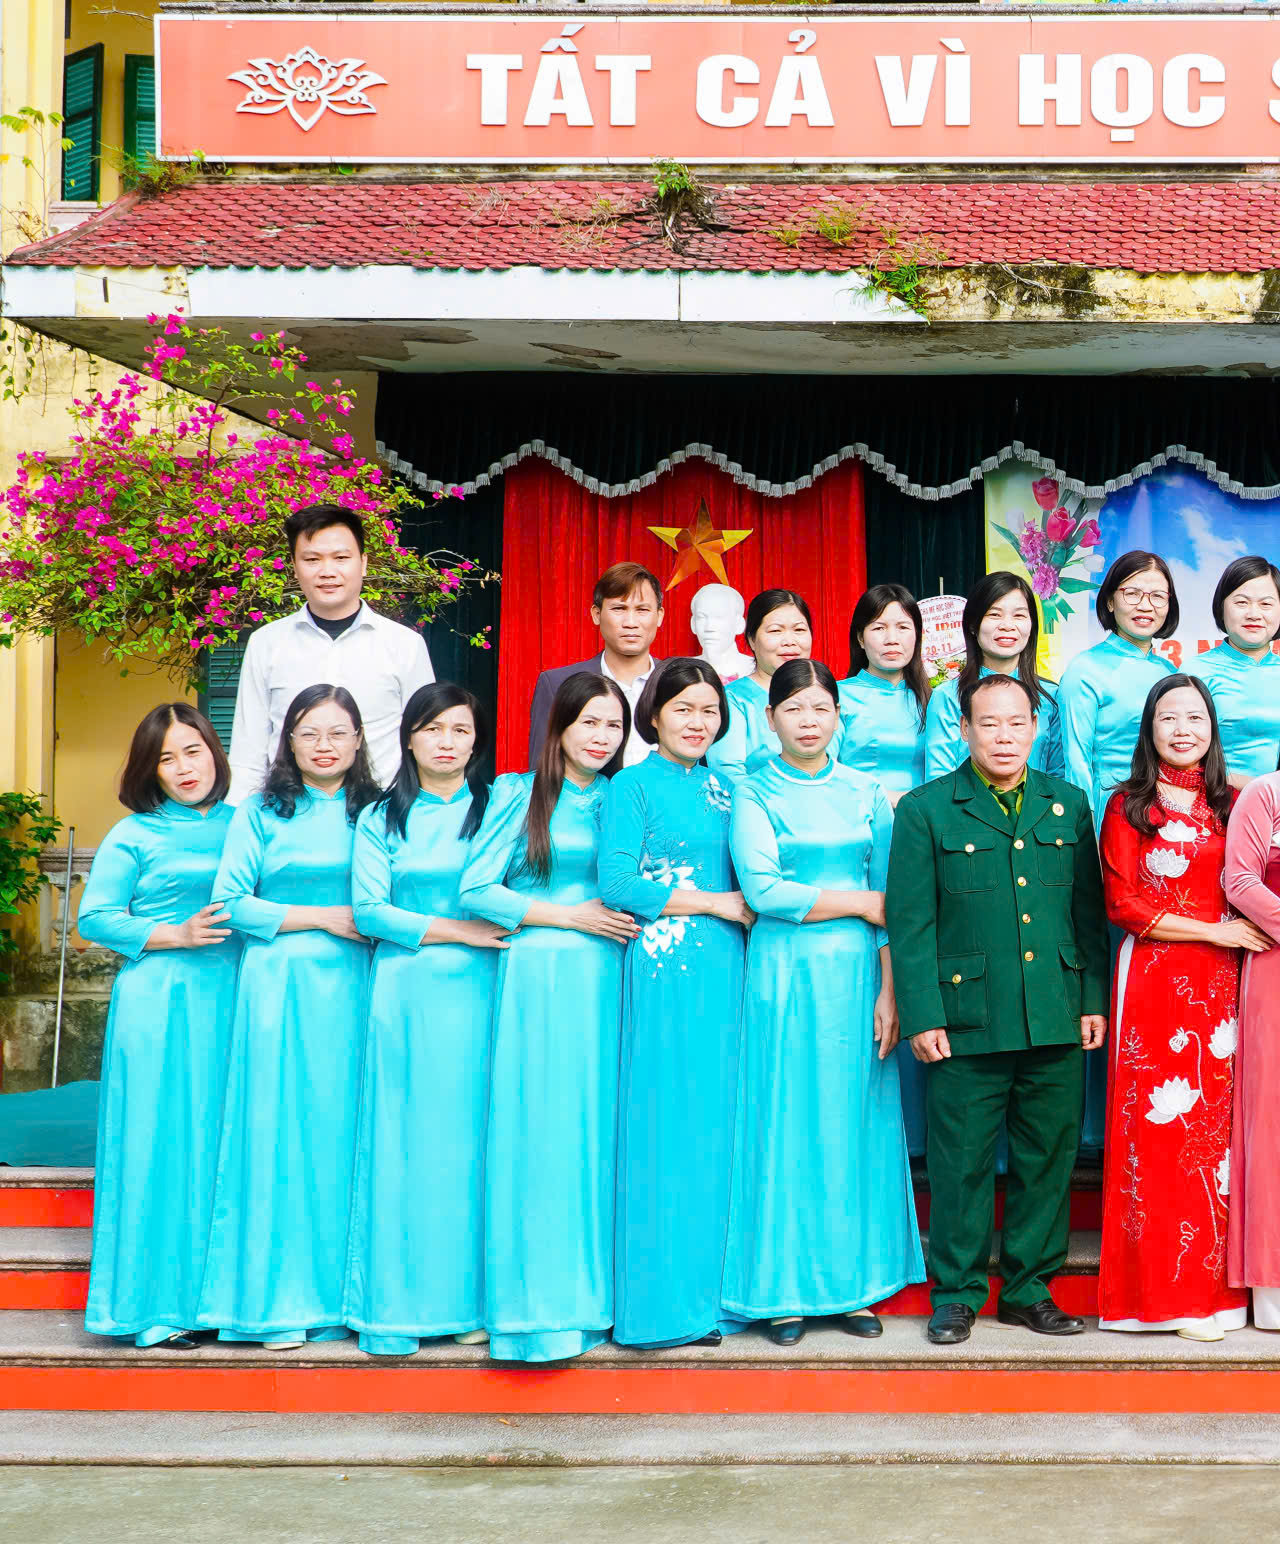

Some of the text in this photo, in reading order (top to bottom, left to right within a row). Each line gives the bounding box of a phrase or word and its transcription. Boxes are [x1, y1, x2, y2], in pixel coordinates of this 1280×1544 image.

[466, 23, 652, 126] TẤT
[695, 29, 834, 127] CẢ
[875, 37, 971, 126] VÌ
[1018, 53, 1226, 141] HỌC
